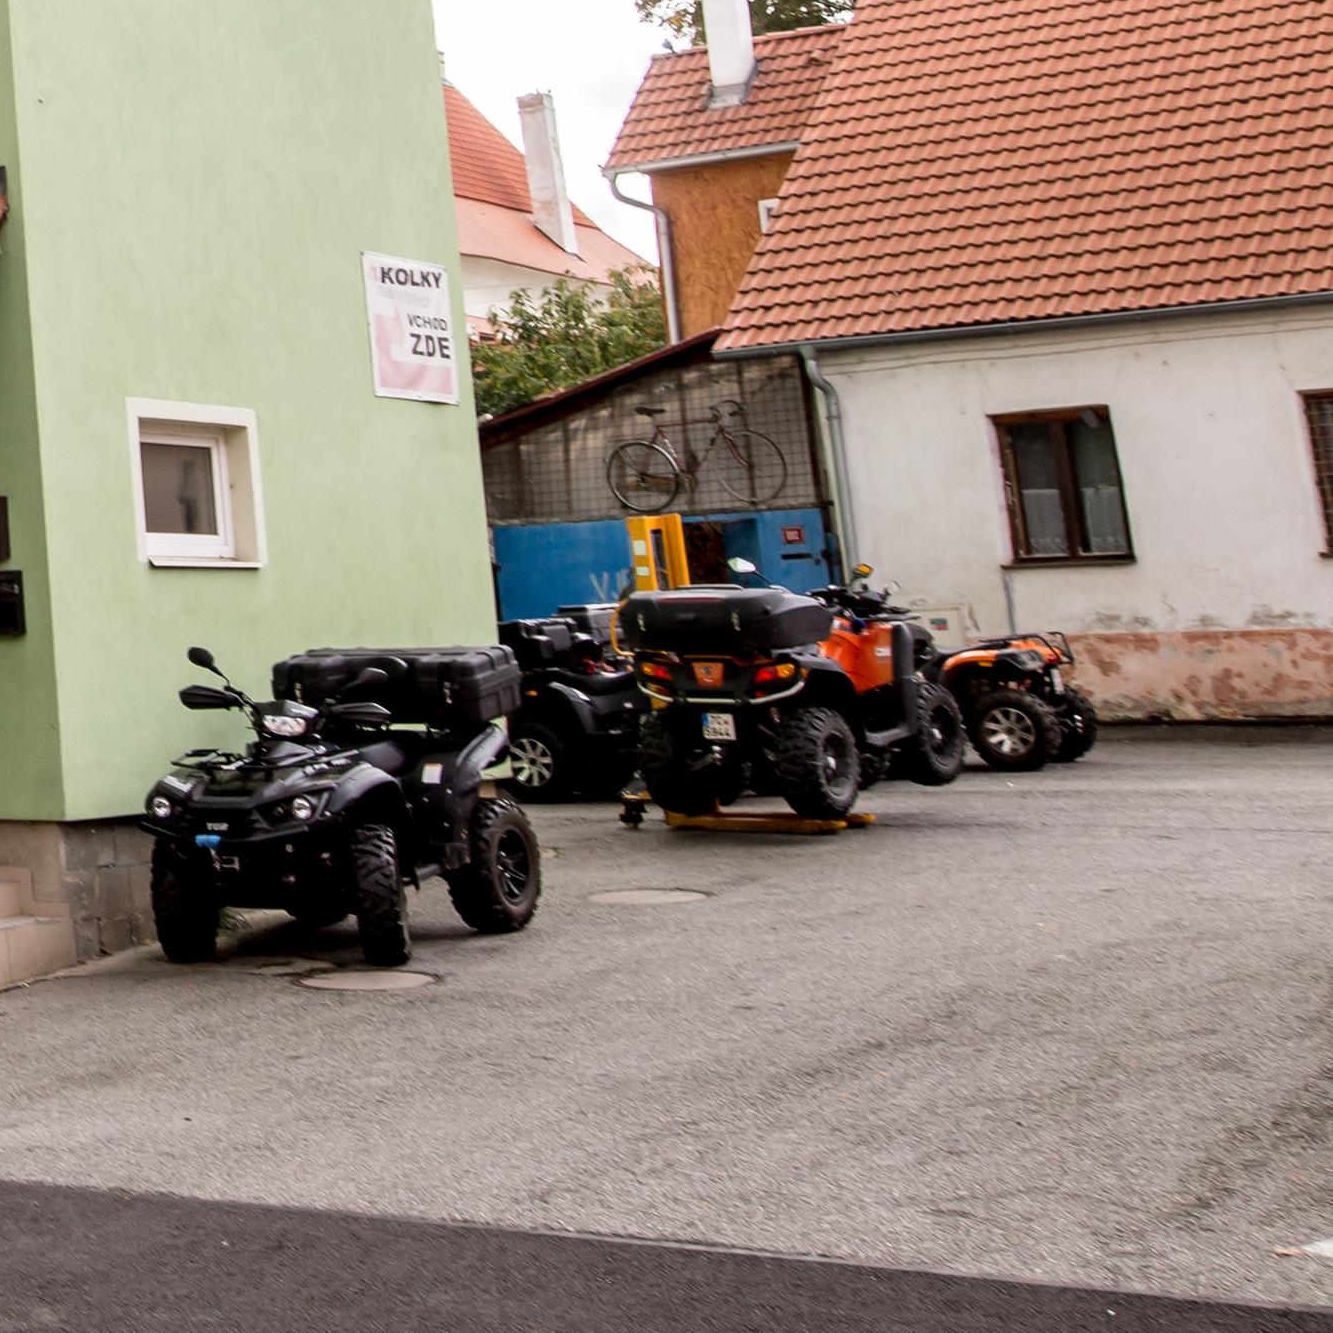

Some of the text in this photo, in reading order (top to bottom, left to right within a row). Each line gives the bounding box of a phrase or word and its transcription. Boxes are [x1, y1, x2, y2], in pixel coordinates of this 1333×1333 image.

[371, 266, 442, 289] KOLKY
[406, 313, 448, 332] VCHOD
[410, 333, 451, 359] ZDE
